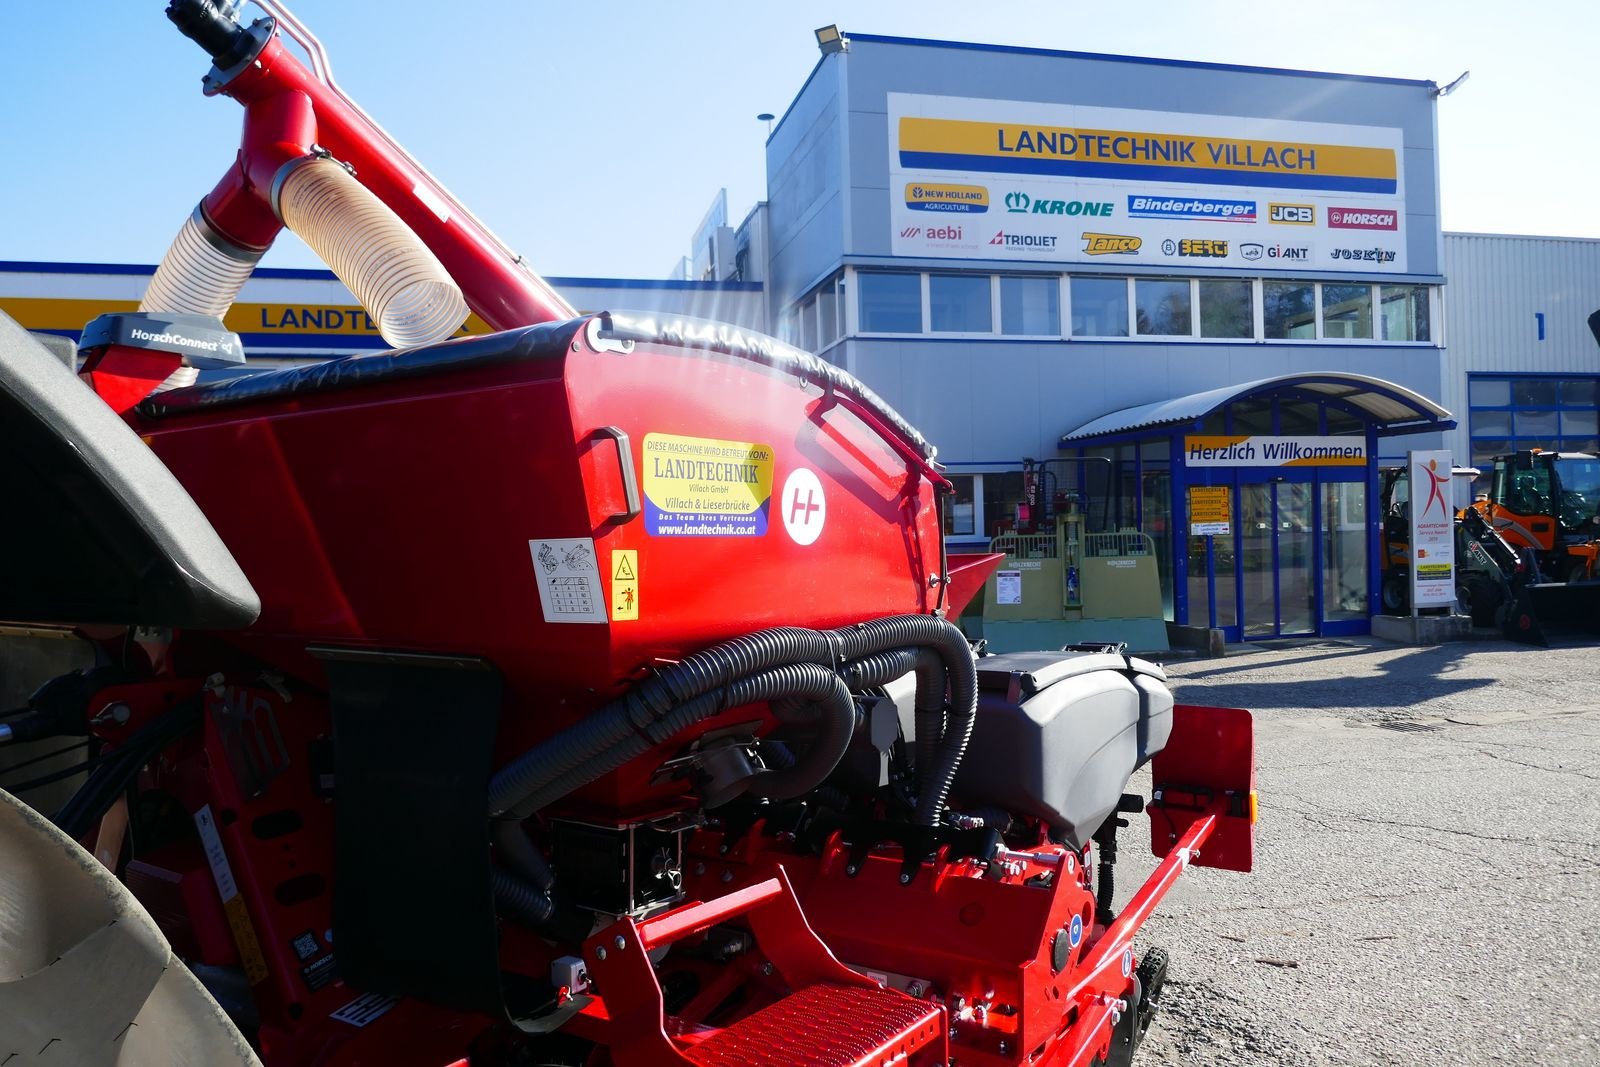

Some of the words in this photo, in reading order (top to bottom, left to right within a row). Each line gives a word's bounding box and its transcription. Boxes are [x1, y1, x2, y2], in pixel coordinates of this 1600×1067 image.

[998, 129, 1197, 163] LANDTECHNIK
[1206, 143, 1317, 170] VILLACH
[925, 190, 943, 198] NEW
[945, 191, 982, 200] HOLLAND
[924, 203, 970, 212] AGRICULTURE
[1032, 200, 1115, 217] KRONE
[1132, 198, 1253, 215] Binderberger
[1271, 206, 1313, 222] JCB
[1342, 213, 1394, 226] HORSCH
[926, 226, 962, 241] aebi
[1003, 234, 1057, 247] TRIOLIET
[1081, 231, 1142, 251] Tanco
[1330, 248, 1397, 263] JOSKIN
[262, 308, 382, 330] LANDTE
[1534, 312, 1545, 341] 1
[131, 328, 218, 352] HorschConnect
[647, 440, 667, 451] DIESE
[668, 443, 702, 454] MASCHINE
[704, 446, 721, 456] WIRD
[722, 448, 748, 458] BETREUT
[749, 450, 769, 460] VON:
[1190, 442, 1256, 460] Herzlich
[1263, 443, 1363, 460] Willkommen
[654, 457, 759, 484] LANDTECHNIK
[689, 484, 710, 493] Villach
[710, 485, 729, 493] GmbH
[665, 497, 693, 510] Villach
[695, 500, 701, 509] &
[703, 500, 750, 511] Lieserbrücke
[658, 513, 673, 521] Das
[698, 514, 717, 522] Ihres
[720, 514, 756, 522] Vertrauens
[658, 523, 756, 535] www.landtechnik.co.at
